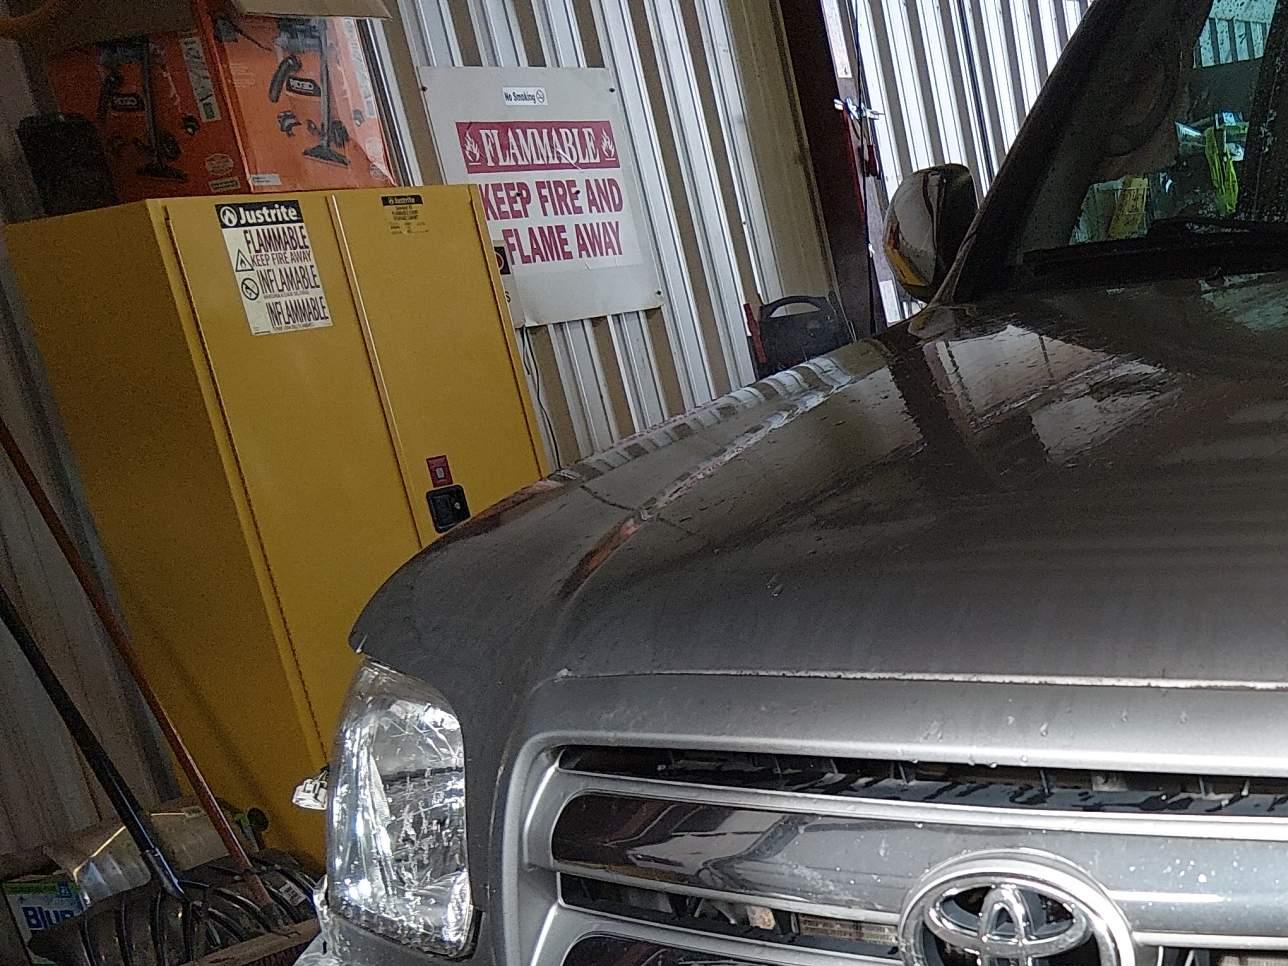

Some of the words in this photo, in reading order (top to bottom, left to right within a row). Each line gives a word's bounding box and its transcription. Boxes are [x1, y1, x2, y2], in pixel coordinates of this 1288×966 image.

[504, 91, 512, 101] No
[512, 92, 537, 104] Smoking
[479, 127, 601, 167] FLAMMABLE
[238, 204, 299, 225] Justrite
[478, 181, 531, 221] KEEP
[535, 179, 584, 217] FIRE
[585, 178, 624, 214] AND
[243, 225, 310, 254] FLAMMABLE
[502, 224, 574, 266] FLAME
[575, 220, 623, 259] AWAY
[250, 253, 271, 268] KEEP
[271, 251, 290, 266] FIRE
[290, 250, 312, 265] AWAY
[256, 264, 321, 295] INFLAMABLE
[265, 295, 330, 330] INFLAMMABLE
